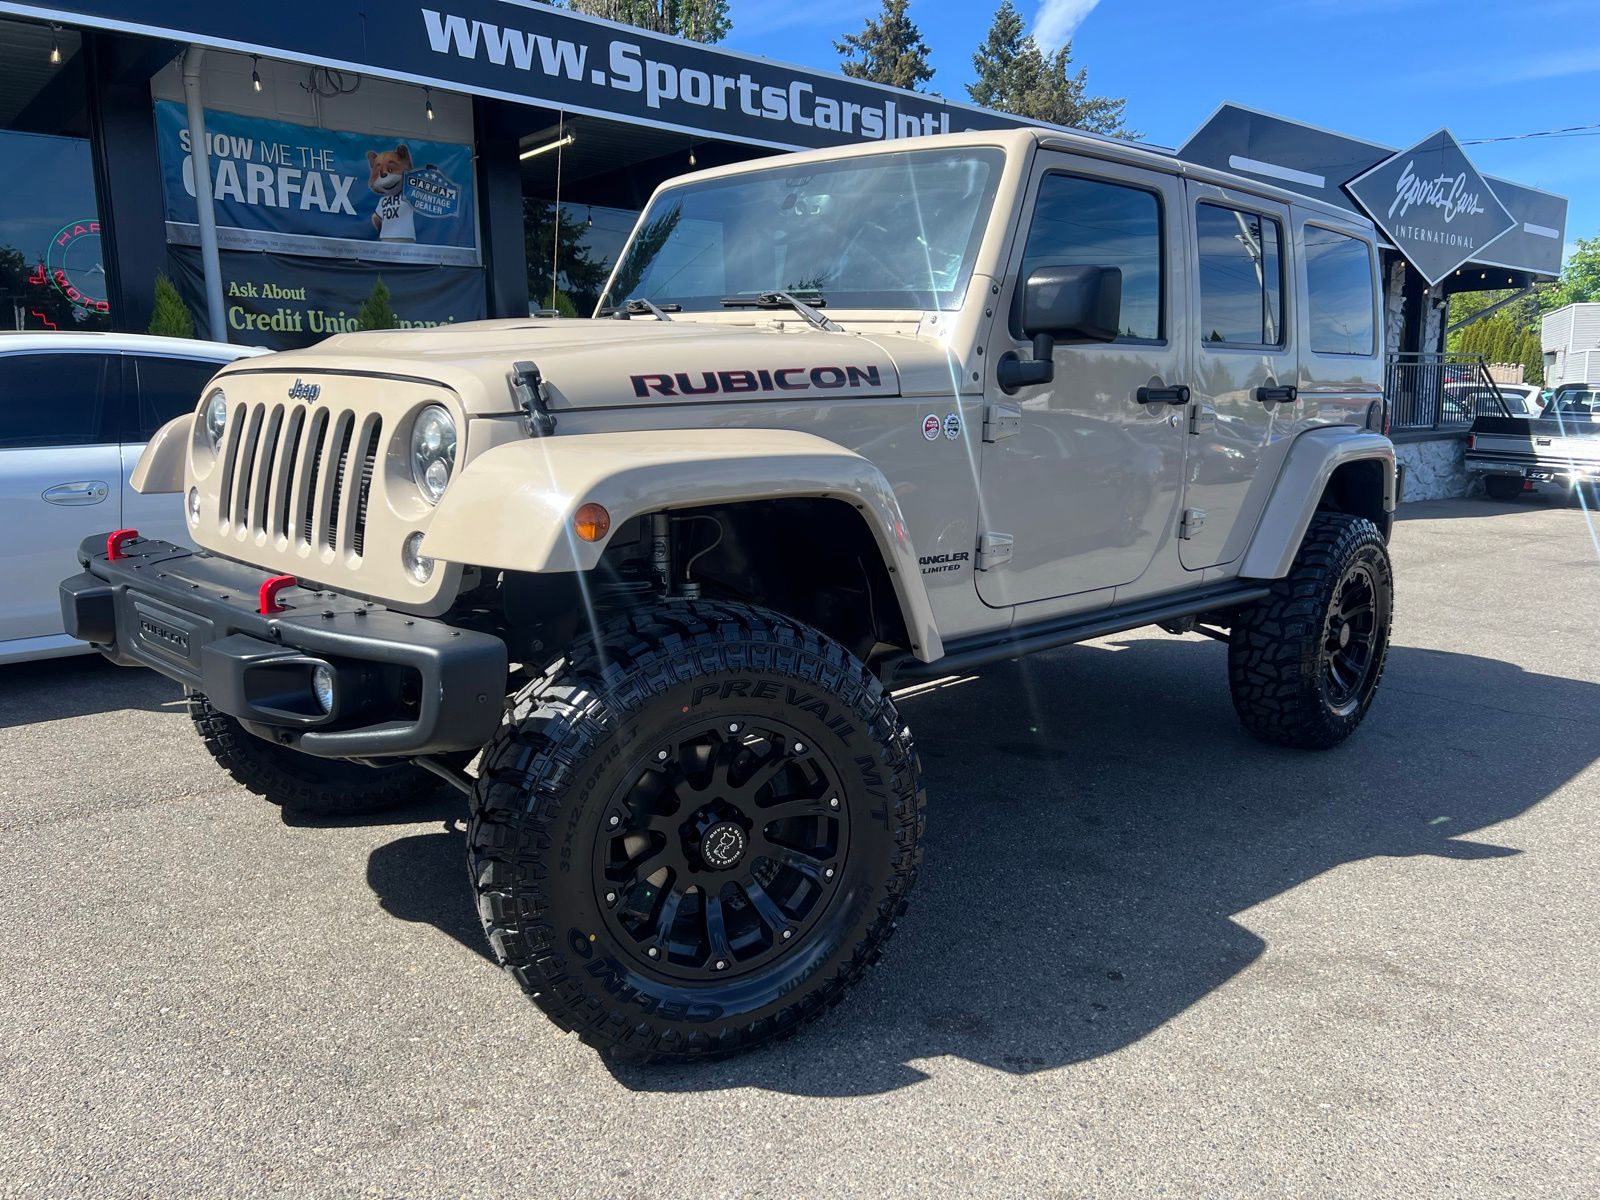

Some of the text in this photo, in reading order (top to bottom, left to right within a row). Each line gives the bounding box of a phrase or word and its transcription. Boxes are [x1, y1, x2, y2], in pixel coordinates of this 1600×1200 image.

[421, 8, 950, 141] www.SportsCarsIntl
[260, 141, 293, 166] ME
[296, 146, 335, 172] THE
[409, 177, 456, 200] CARFAX
[411, 190, 451, 208] ADVANTAGE
[1388, 160, 1484, 223] Sports Cars
[382, 206, 399, 219] FOX
[414, 200, 443, 215] DEALER
[1395, 224, 1474, 249] INTERNATIONAL
[229, 281, 306, 301] Ask About
[229, 305, 362, 333] Credit Unio
[288, 377, 321, 405] Jeep
[630, 365, 882, 398] RUBICON
[918, 551, 970, 566] ANGLER
[922, 563, 961, 575] LIMITED
[690, 678, 856, 748] PREVAIL
